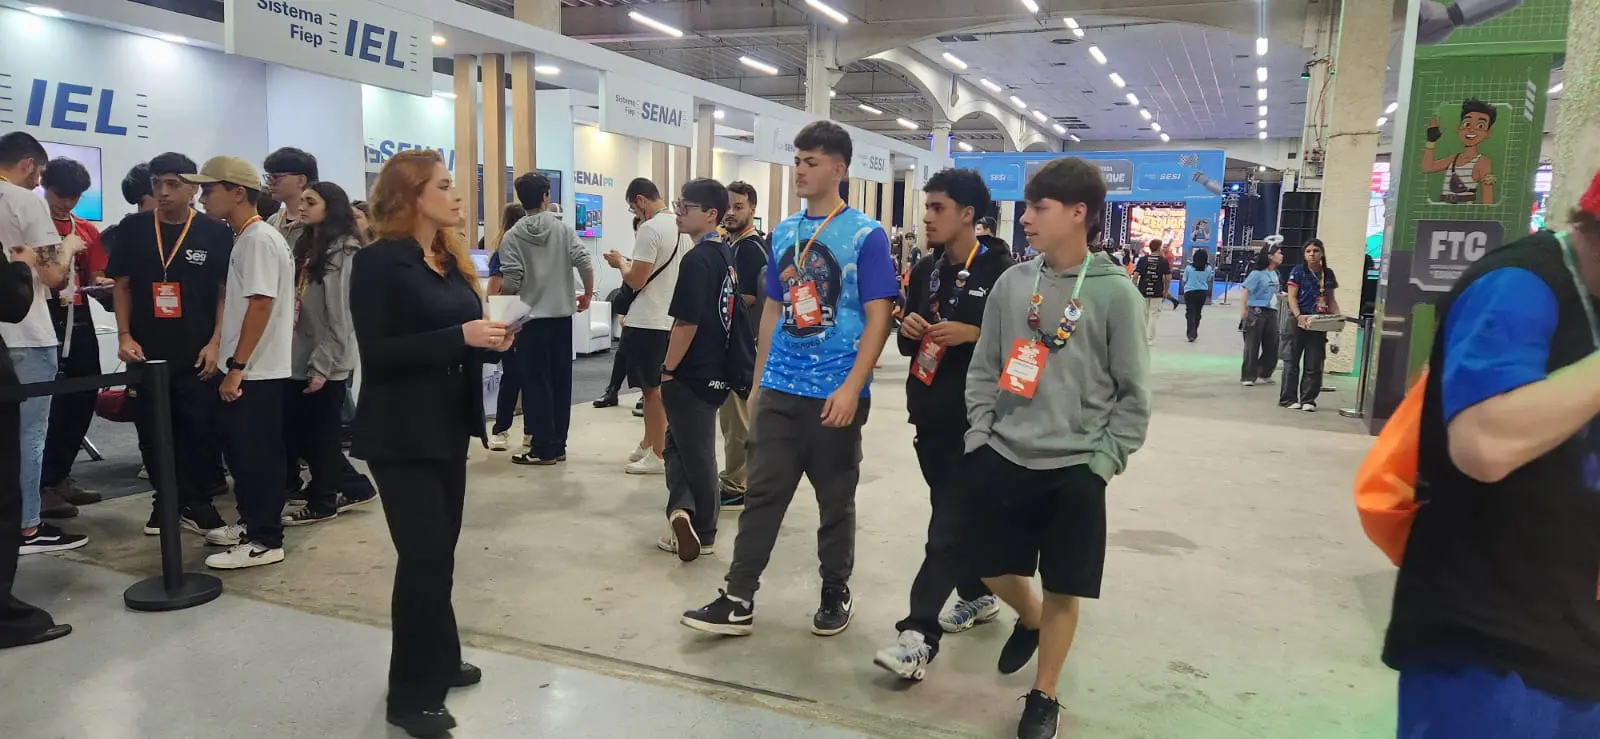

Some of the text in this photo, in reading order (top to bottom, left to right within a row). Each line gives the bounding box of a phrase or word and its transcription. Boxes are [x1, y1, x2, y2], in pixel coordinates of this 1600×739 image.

[257, 0, 323, 25] Sistema
[290, 23, 323, 48] Fiep
[344, 19, 405, 69] IEL
[25, 78, 128, 136] IEL
[641, 101, 682, 127] SENAI
[869, 155, 885, 171] SESI
[1429, 231, 1487, 262] FTC
